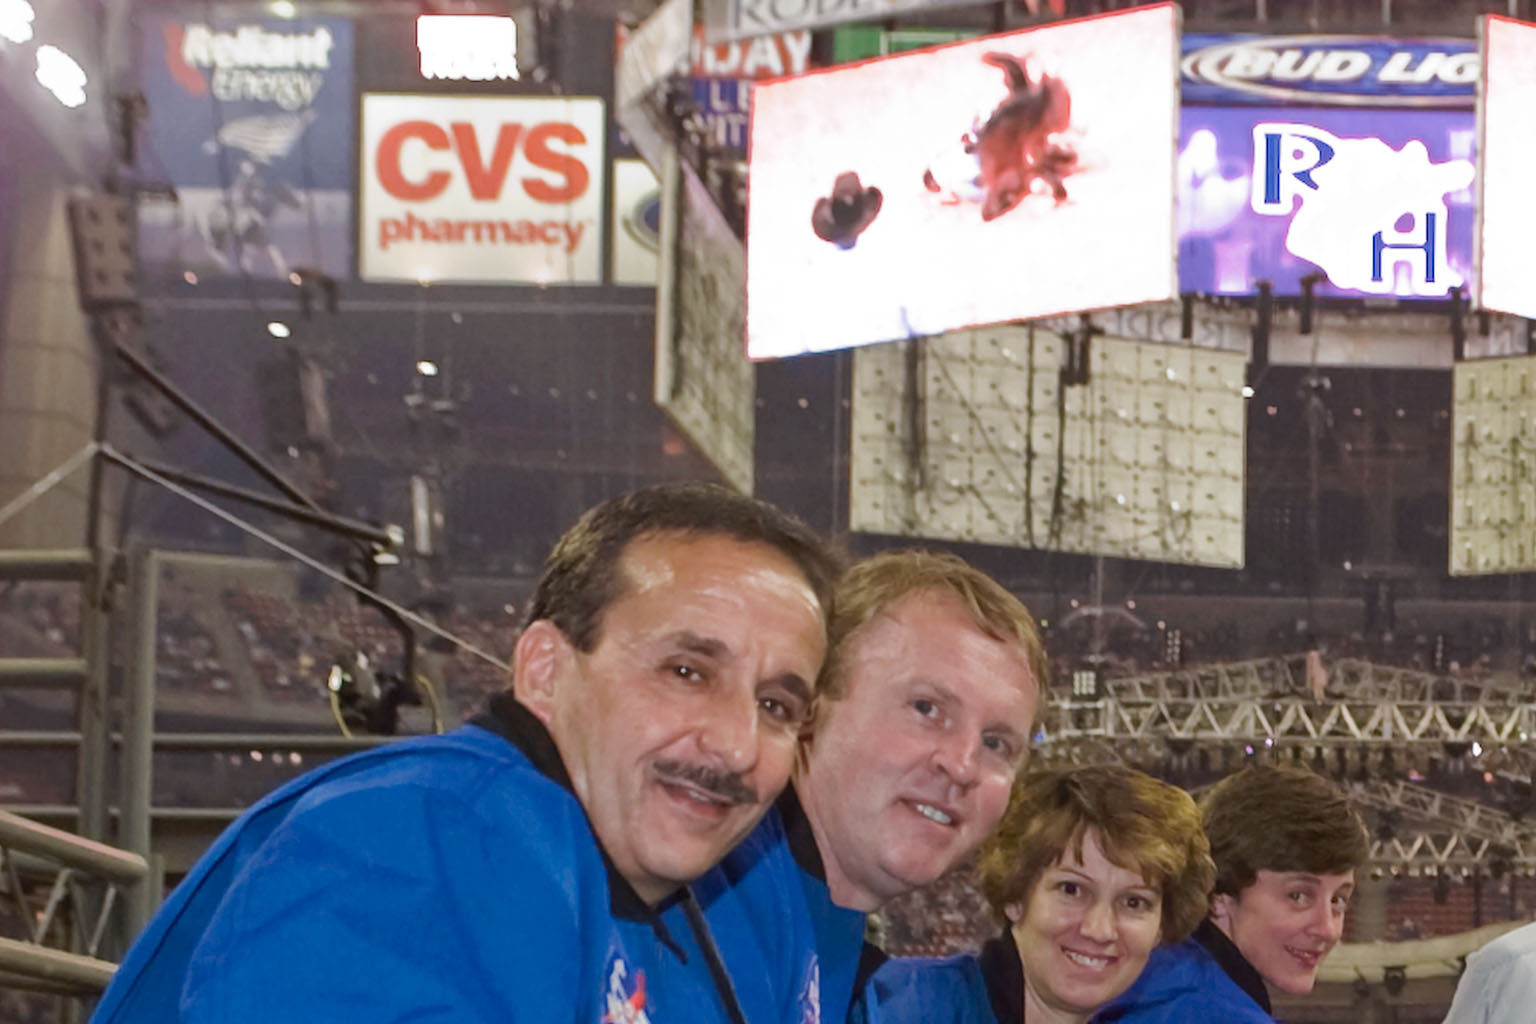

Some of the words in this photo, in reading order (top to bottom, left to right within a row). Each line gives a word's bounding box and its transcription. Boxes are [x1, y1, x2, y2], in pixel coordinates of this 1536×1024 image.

[1221, 47, 1372, 82] BUD
[376, 120, 590, 204] CVS
[1264, 132, 1336, 205] R
[379, 211, 586, 254] pharmacy
[1371, 212, 1436, 283] H
